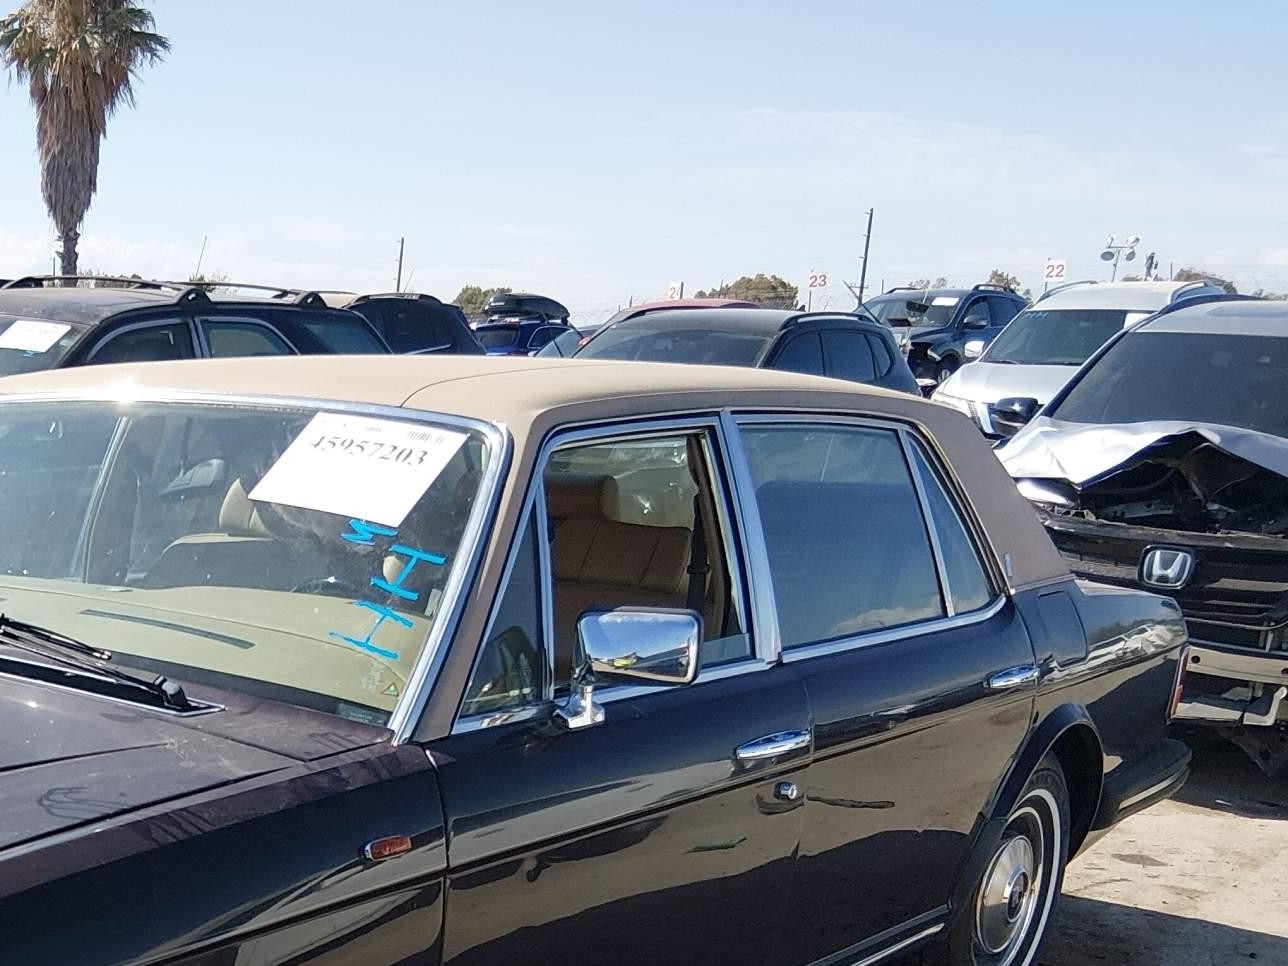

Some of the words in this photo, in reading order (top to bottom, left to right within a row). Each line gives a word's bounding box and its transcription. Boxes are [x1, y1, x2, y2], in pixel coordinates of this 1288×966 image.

[1046, 264, 1065, 278] 22
[809, 274, 827, 288] 23
[309, 435, 429, 468] 45957203
